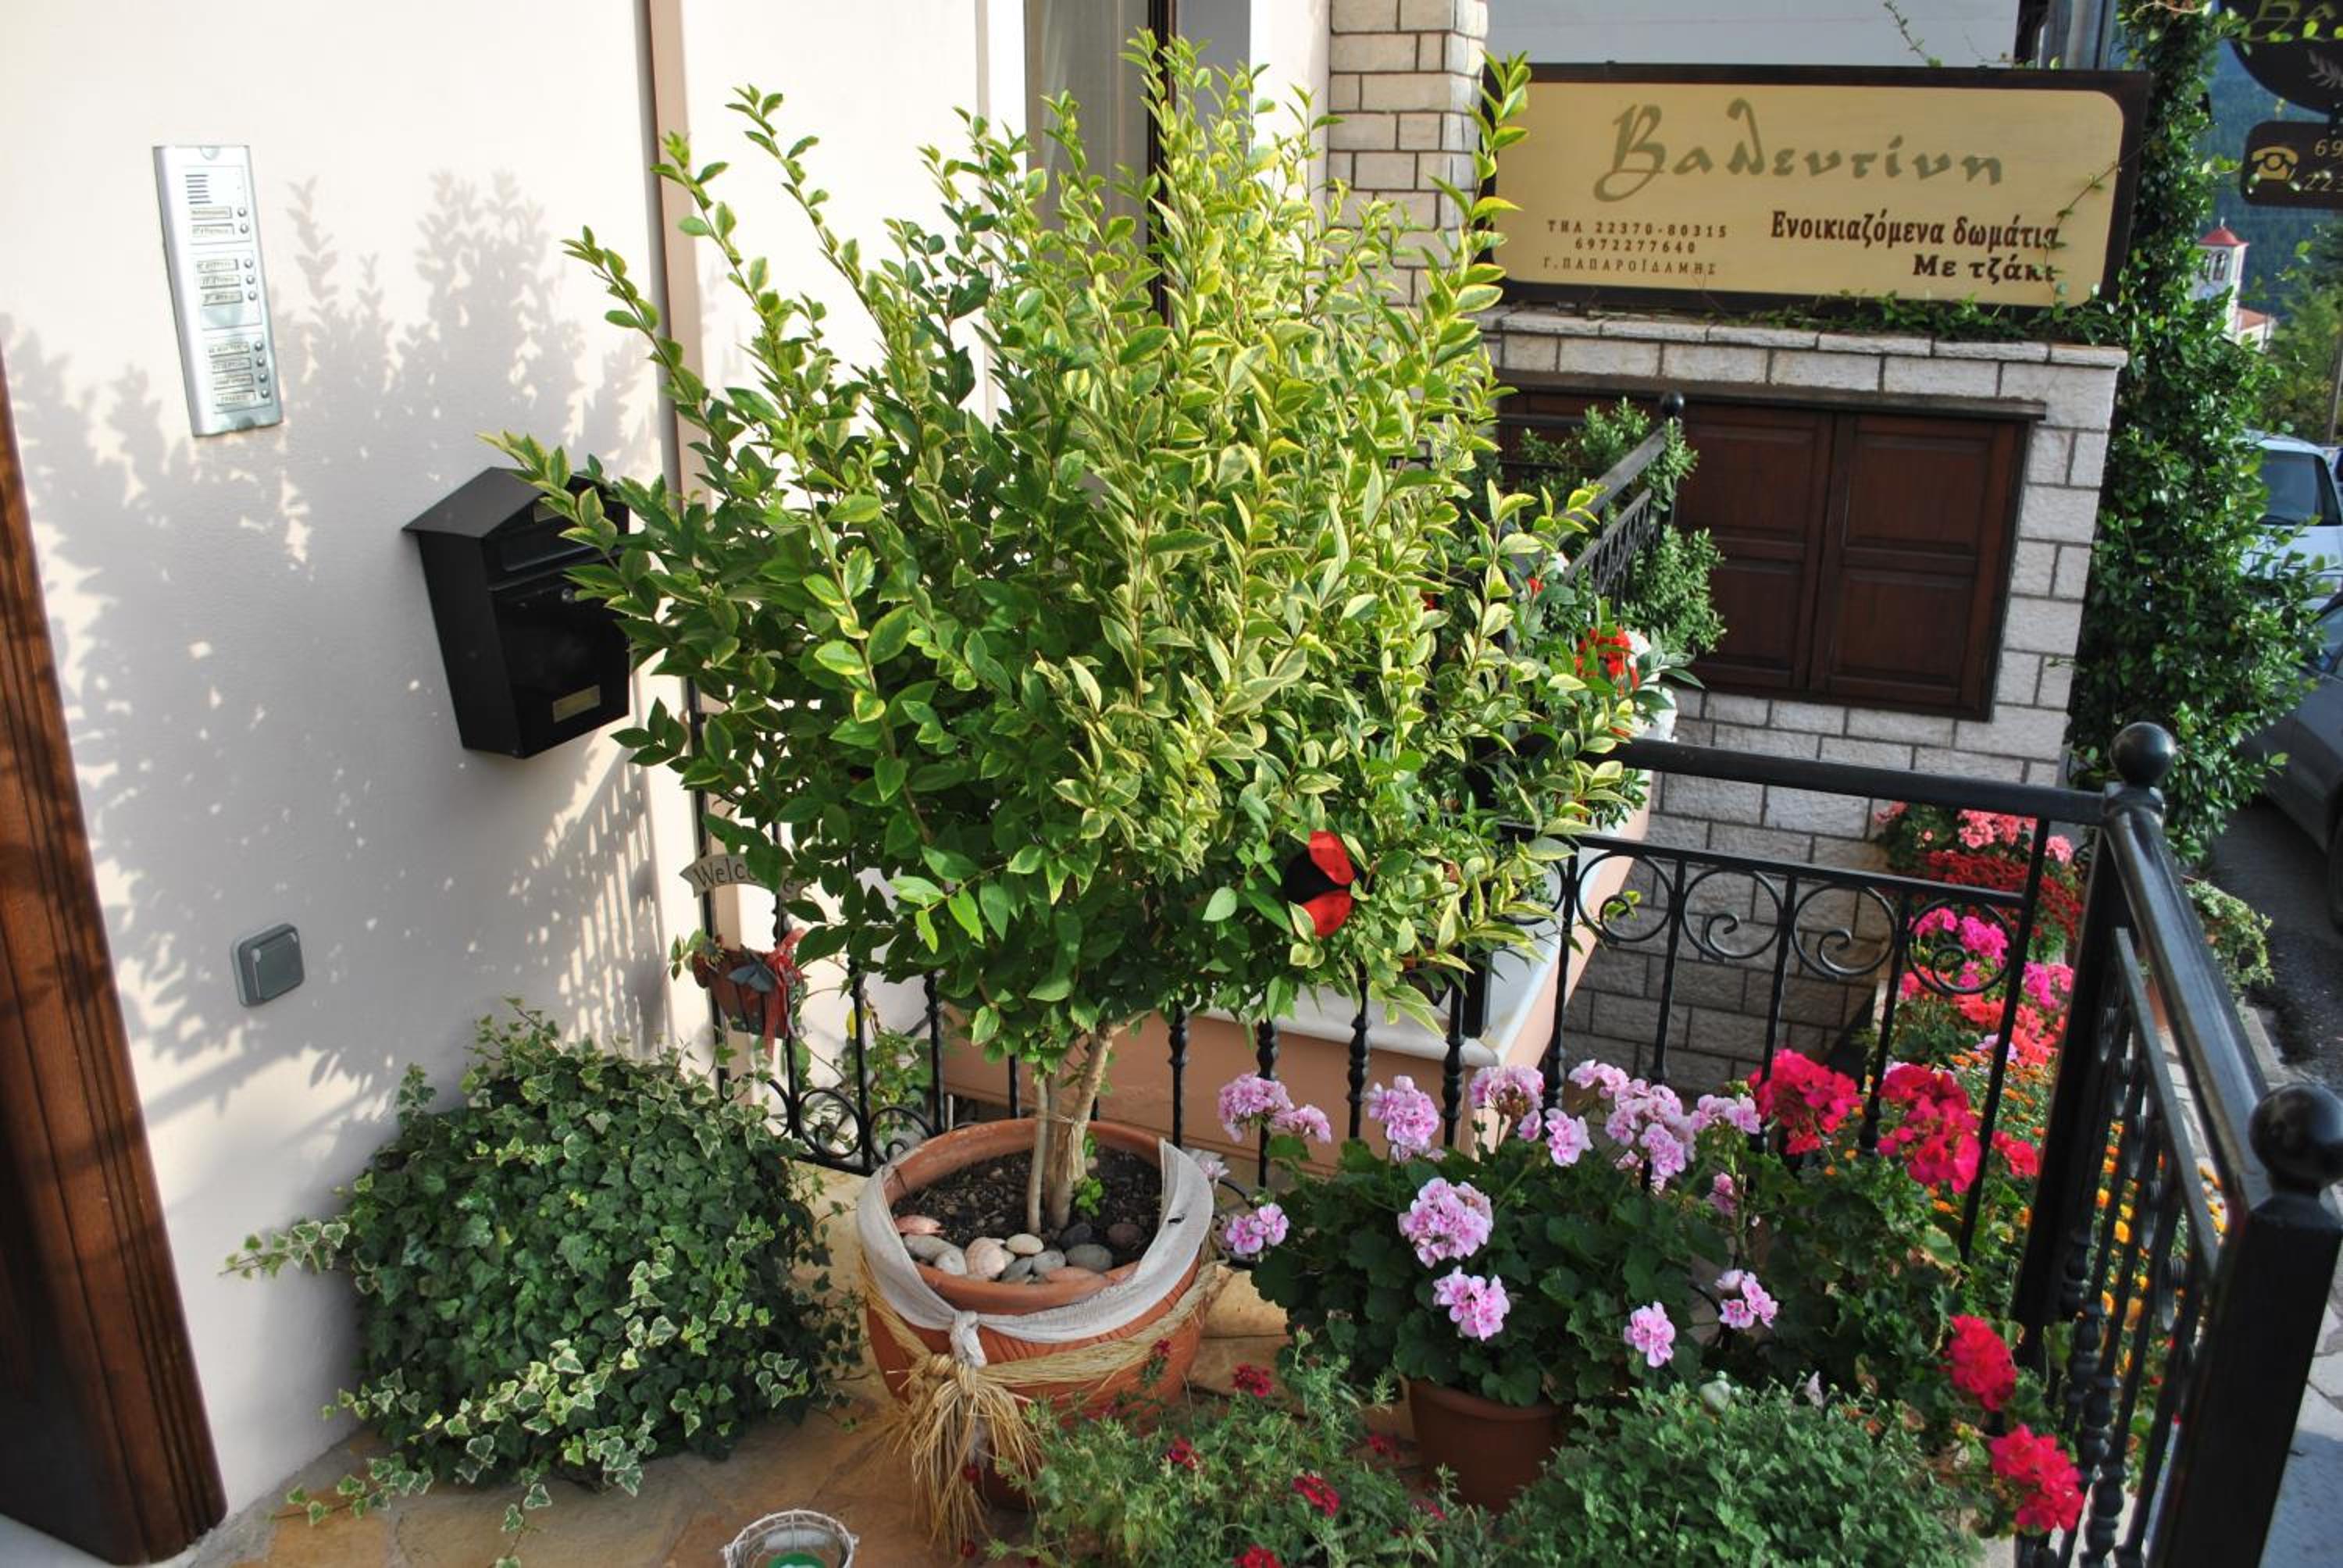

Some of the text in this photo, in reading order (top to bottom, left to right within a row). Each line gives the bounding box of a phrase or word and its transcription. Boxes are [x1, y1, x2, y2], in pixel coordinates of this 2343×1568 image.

[1546, 219, 1727, 238] ΤΗΛ 22370-80315
[1771, 208, 2059, 253] Ενοικιαζόμενα δωμάτια
[1574, 237, 1696, 254] 6972277640
[1913, 254, 1957, 277] Με
[693, 857, 795, 894] Welce
